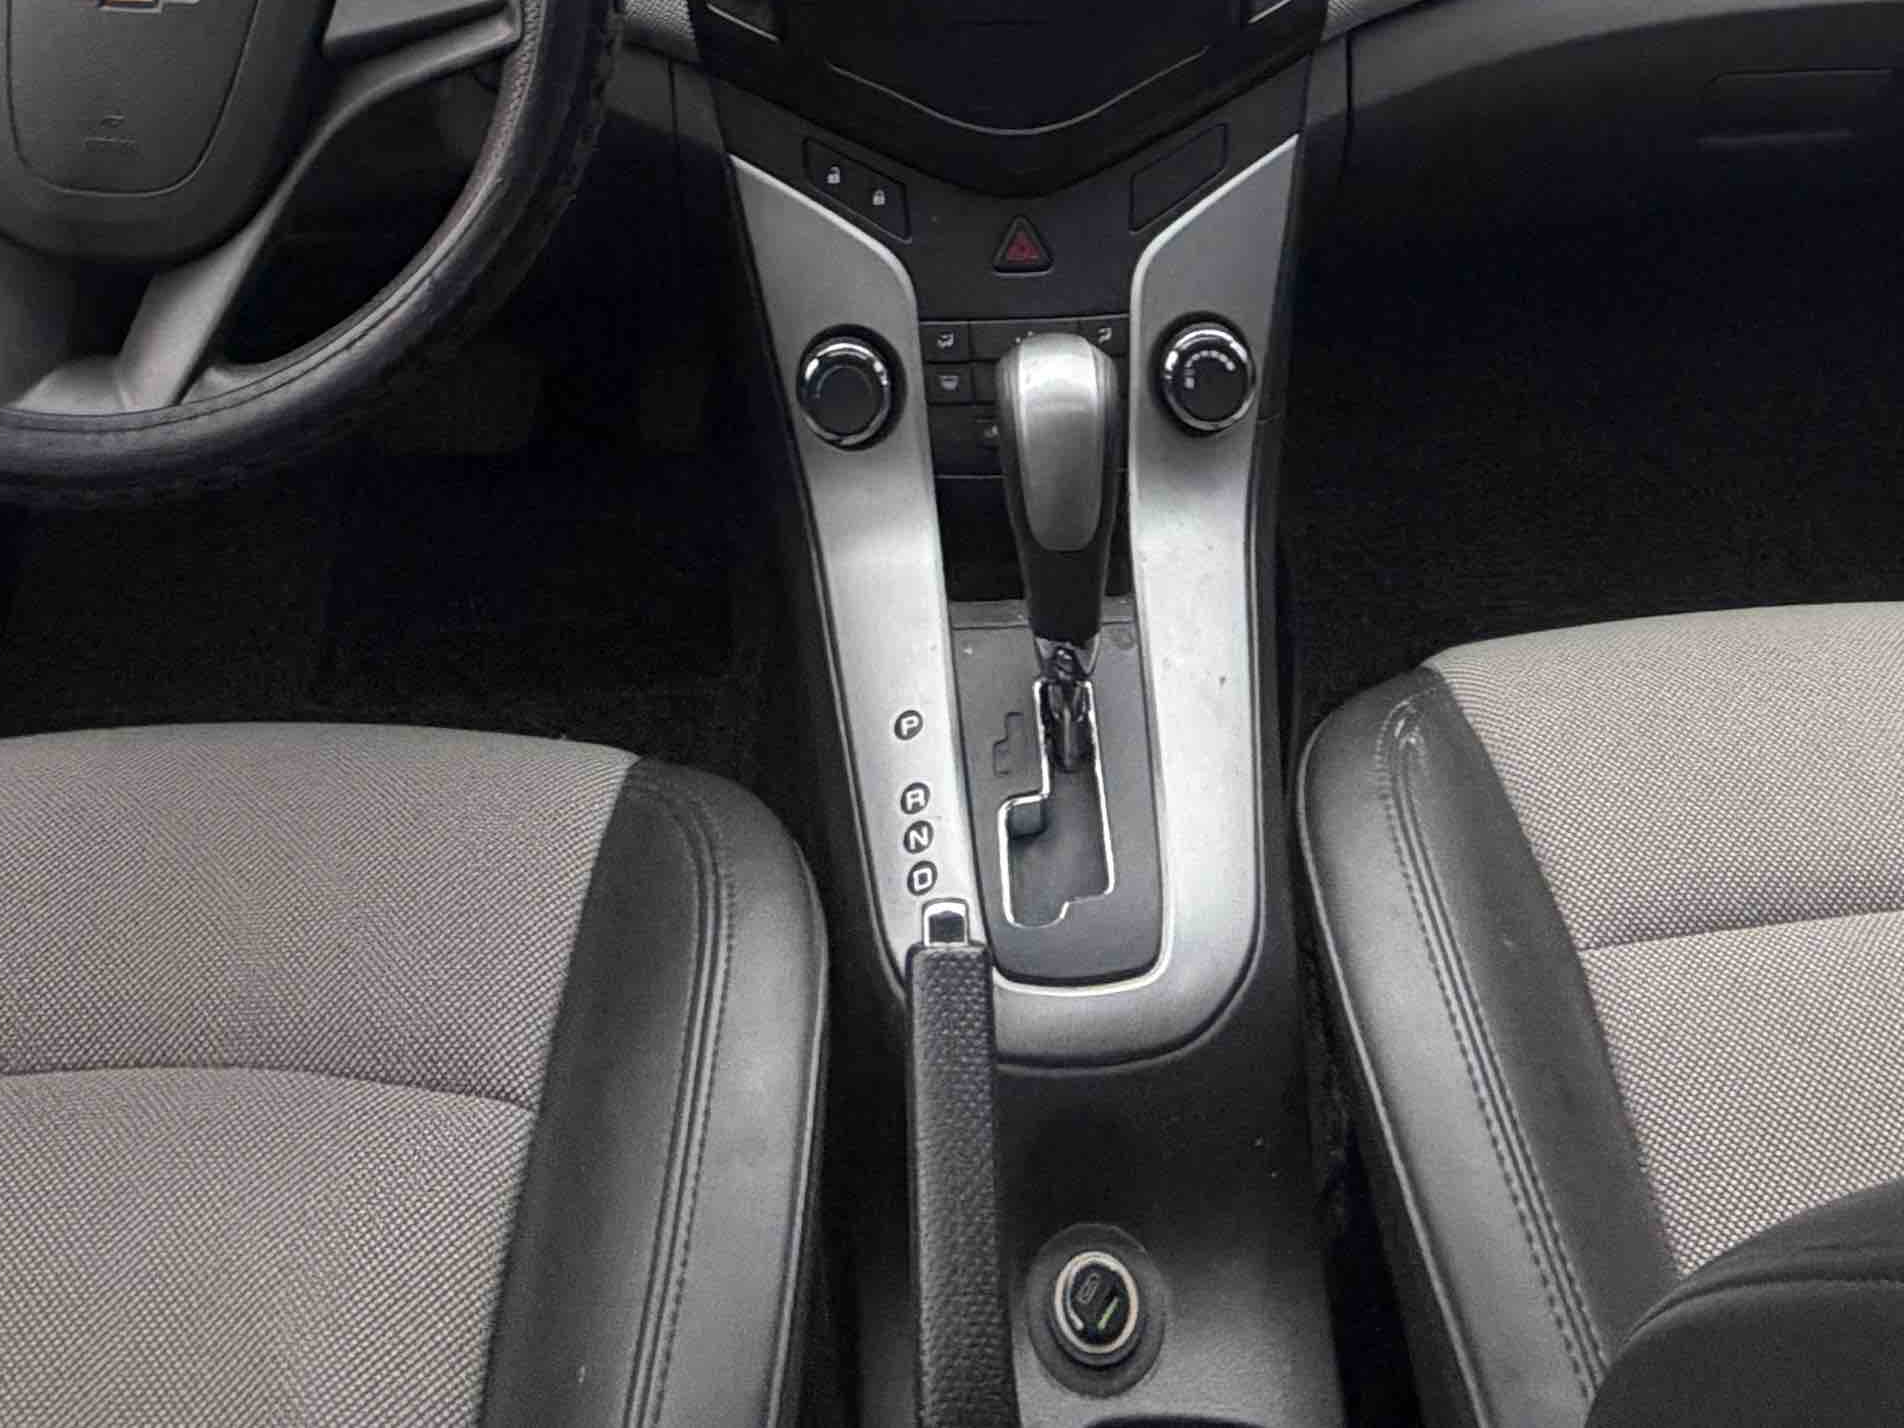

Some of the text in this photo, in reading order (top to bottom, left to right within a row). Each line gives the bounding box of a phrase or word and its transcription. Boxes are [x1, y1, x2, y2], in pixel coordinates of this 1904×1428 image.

[899, 713, 921, 738] P
[907, 824, 930, 852] N
[911, 865, 934, 892] D
